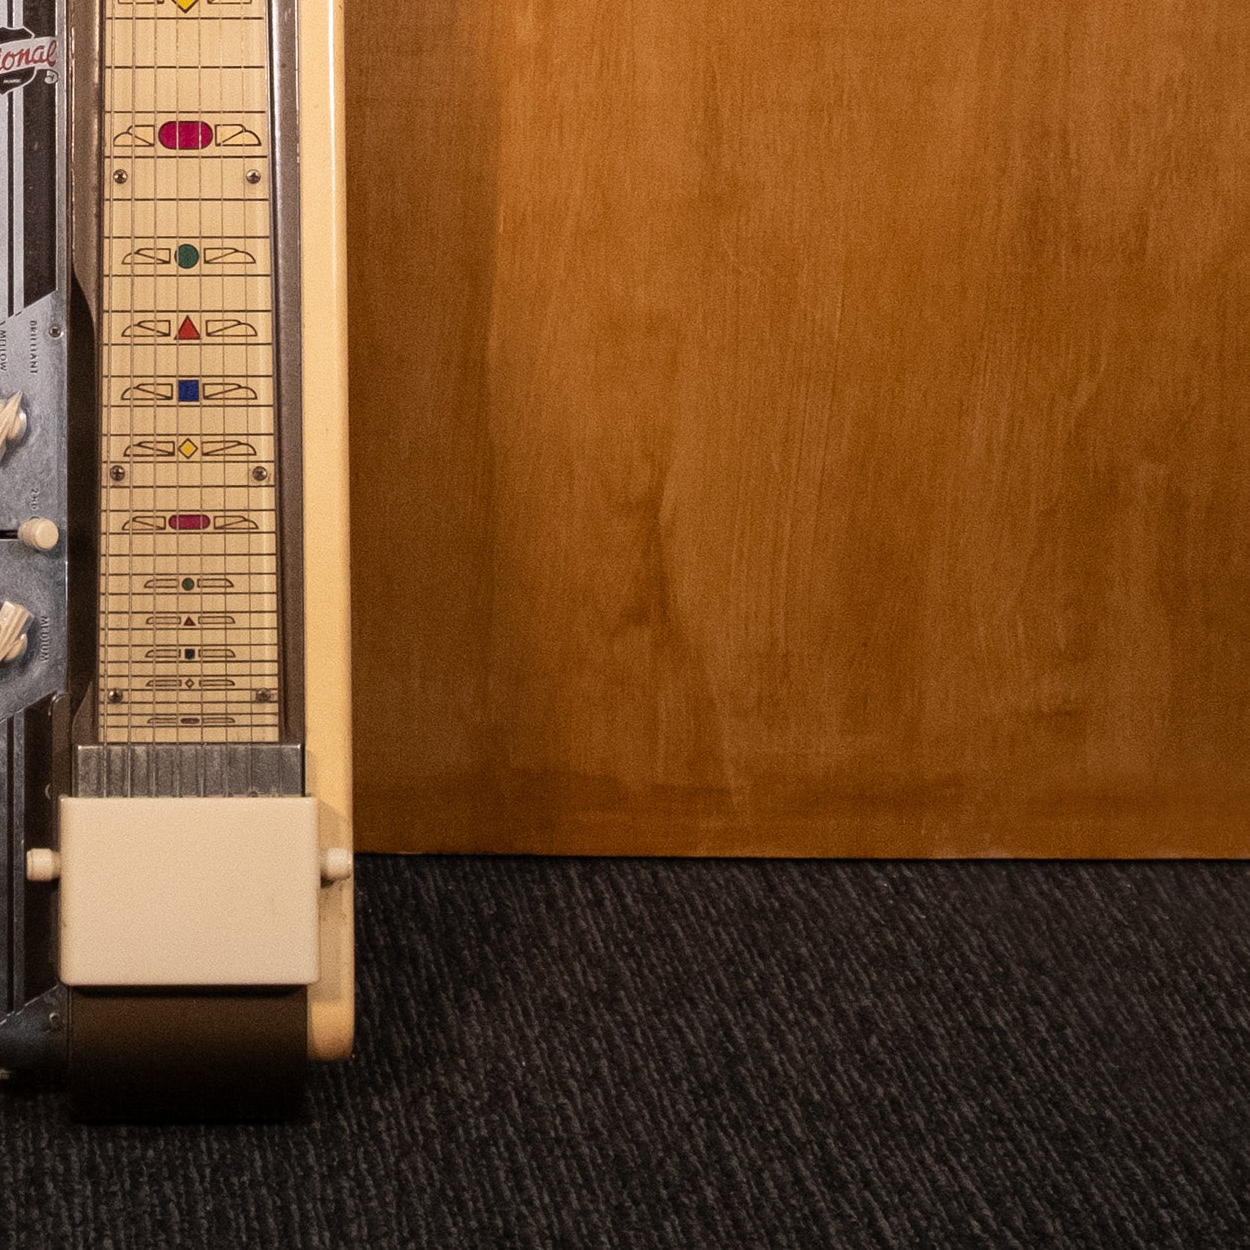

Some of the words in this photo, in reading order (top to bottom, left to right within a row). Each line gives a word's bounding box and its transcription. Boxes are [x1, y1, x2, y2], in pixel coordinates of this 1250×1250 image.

[0, 330, 7, 371] MELLOW
[30, 320, 38, 375] BRILLIANT
[40, 616, 49, 663] MEDIUM
